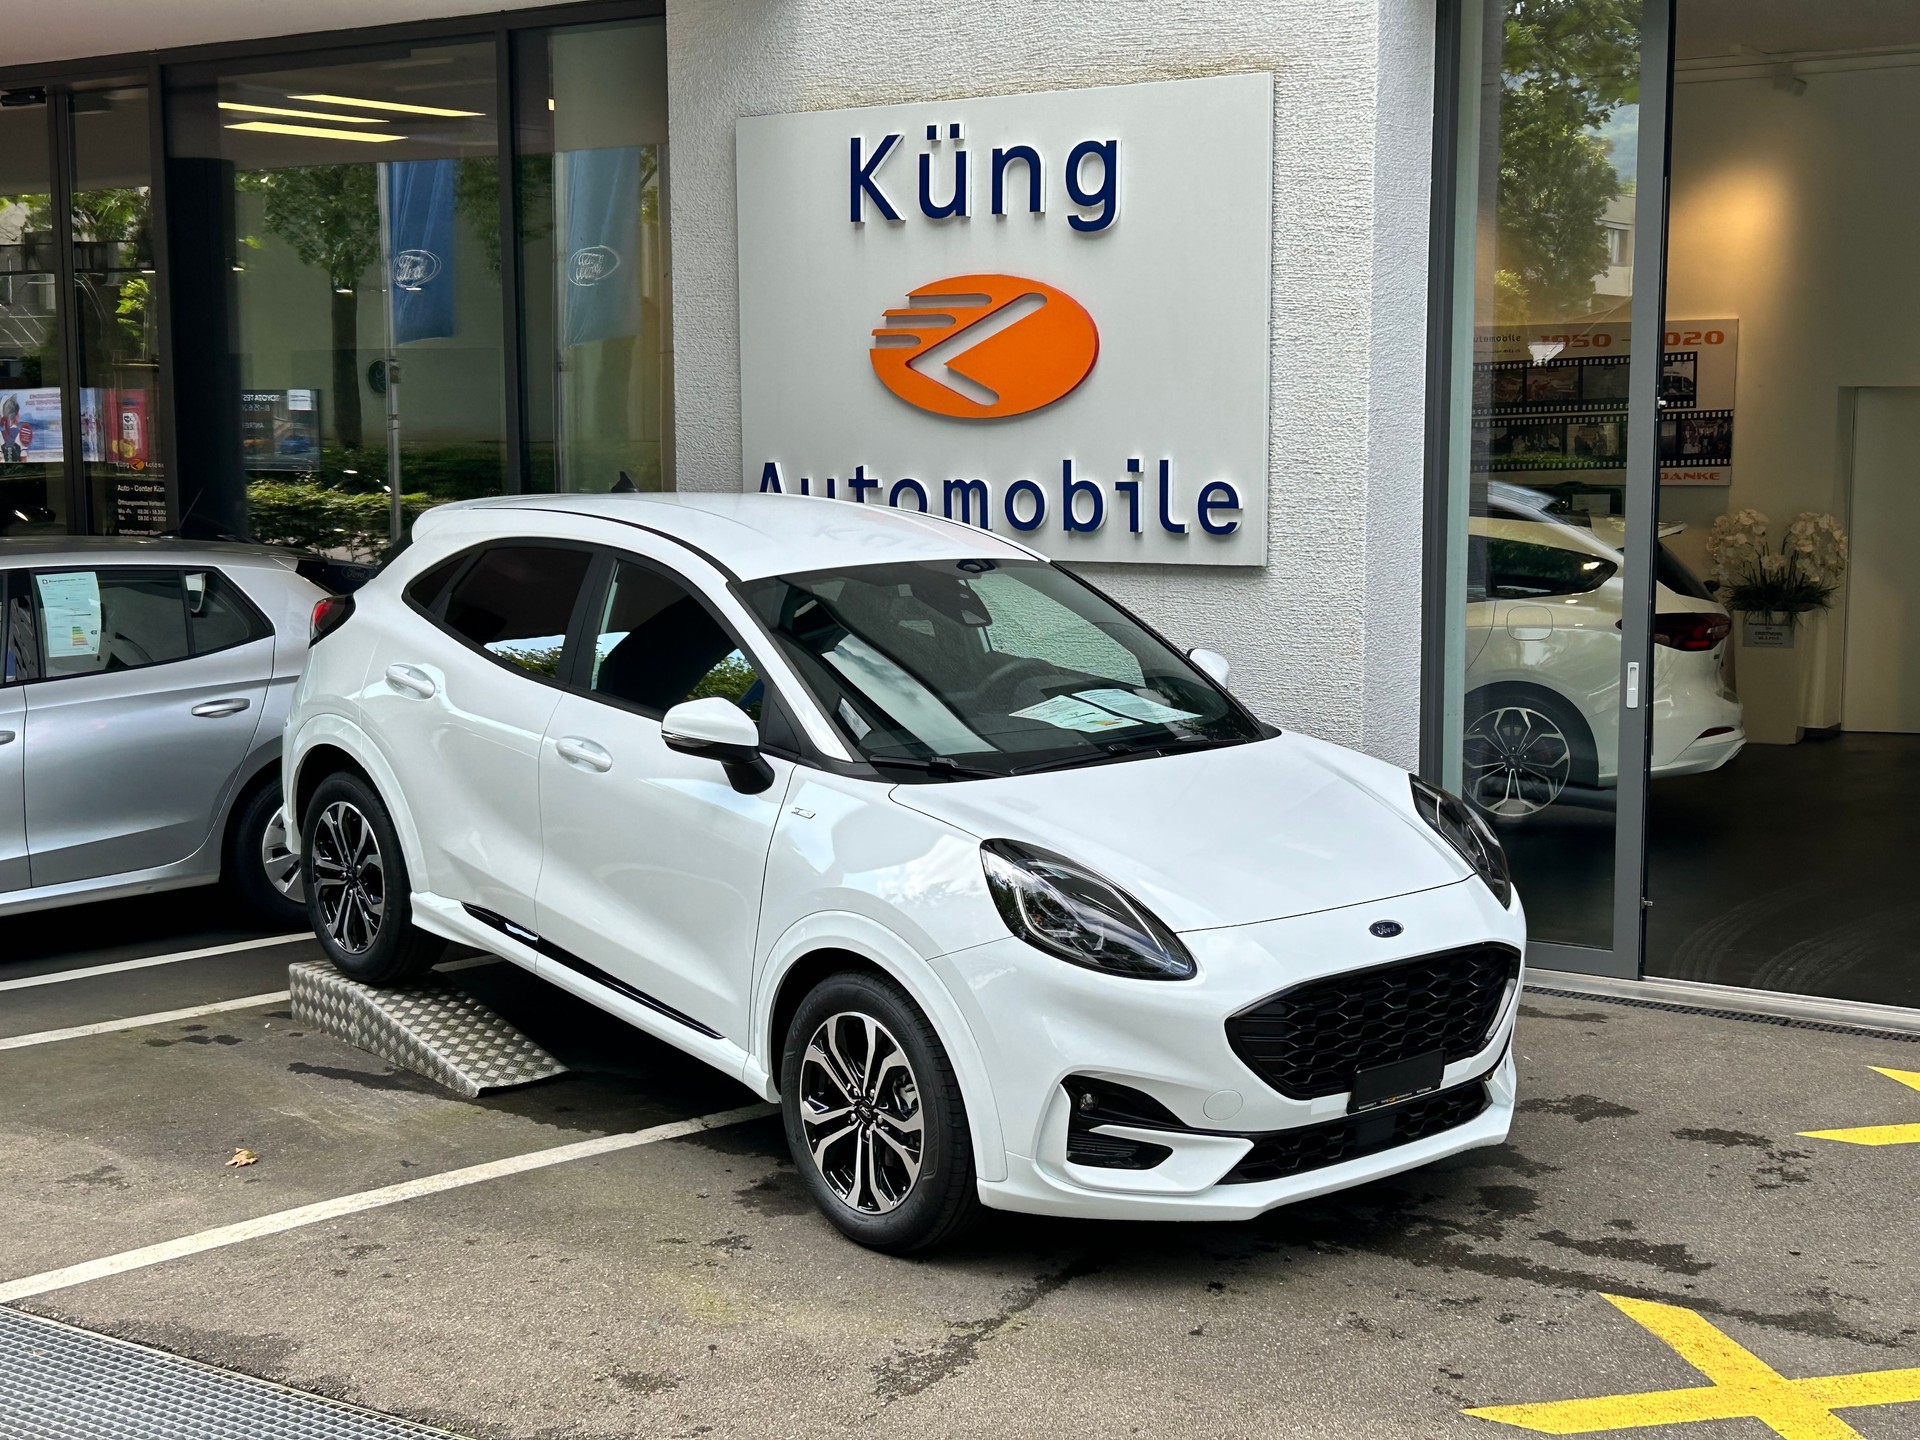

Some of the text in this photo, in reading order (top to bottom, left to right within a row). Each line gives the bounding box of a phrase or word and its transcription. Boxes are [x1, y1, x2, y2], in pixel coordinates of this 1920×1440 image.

[849, 122, 1121, 232] Küng
[1473, 333, 1521, 343] utomobile
[1664, 330, 1725, 346] 020
[1661, 472, 1721, 480] DANKE
